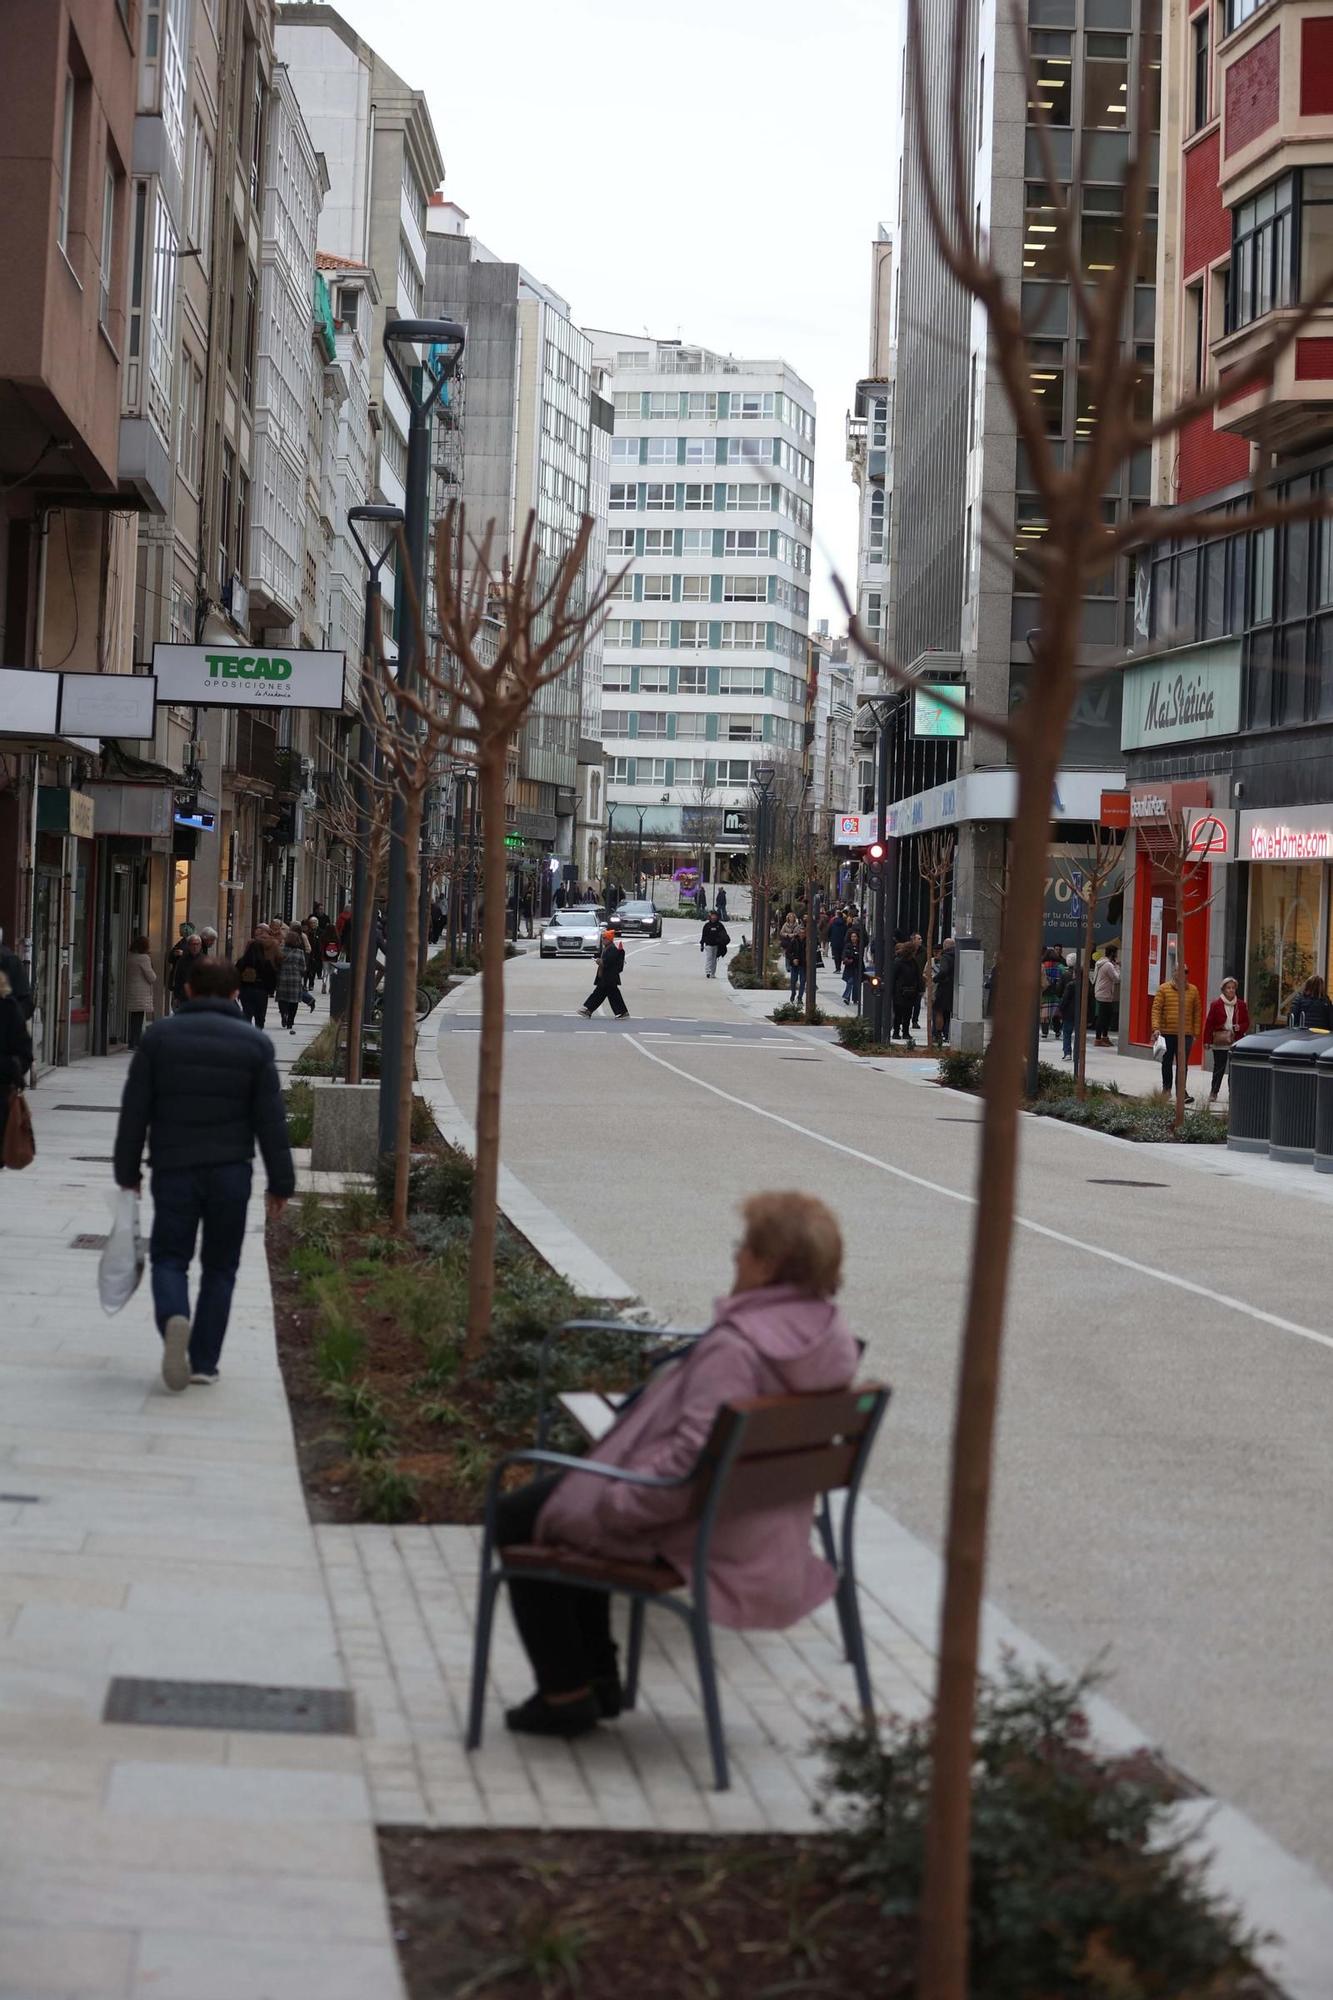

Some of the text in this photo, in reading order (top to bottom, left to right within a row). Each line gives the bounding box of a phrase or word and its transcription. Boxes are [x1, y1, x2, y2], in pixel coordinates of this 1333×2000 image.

[205, 655, 292, 681] TECAD
[204, 680, 291, 690] OPOSICIONES
[1250, 826, 1328, 858] KaveHome.com
